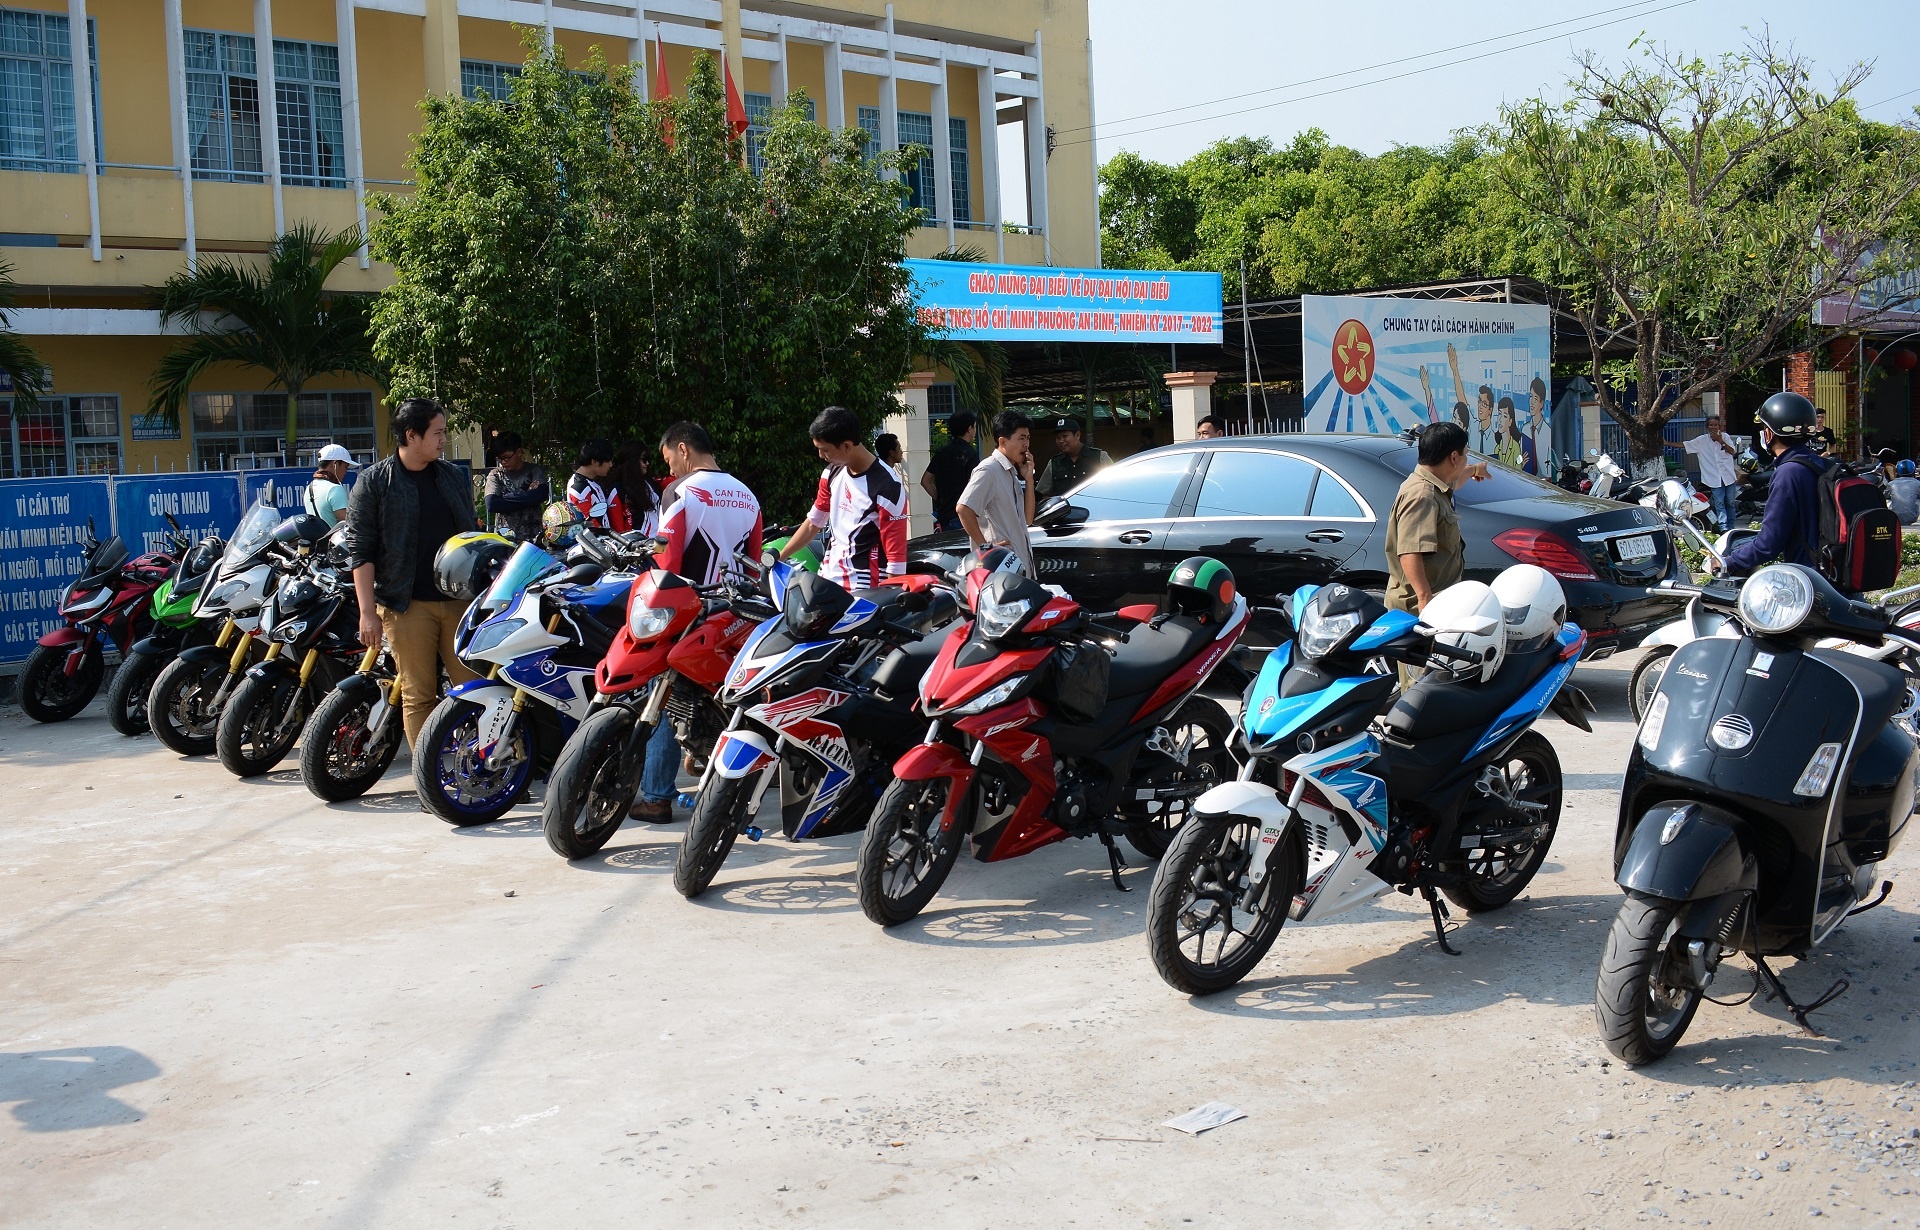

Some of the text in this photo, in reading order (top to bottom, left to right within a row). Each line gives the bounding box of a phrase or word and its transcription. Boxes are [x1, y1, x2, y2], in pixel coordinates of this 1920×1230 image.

[1029, 275, 1046, 300] ĐẠI
[1084, 278, 1097, 302] DỰ
[1098, 279, 1114, 303] ĐẠI
[1115, 276, 1132, 304] HỘI
[1133, 280, 1149, 304] ĐẠI
[948, 307, 973, 329] TNCS
[1009, 309, 1035, 330] MINH
[1078, 311, 1092, 330] AN
[1119, 309, 1147, 337] NHIỆM
[1162, 314, 1183, 333] 2017
[1191, 315, 1212, 333] 2022
[1383, 315, 1515, 334] CHUNG TAY CẢI CÁCH HÀNH CHÍNH
[16, 492, 70, 517] VÌ CẦN THƠ
[149, 489, 210, 517] CÙNG NHAU
[276, 486, 293, 508] CAO
[712, 499, 756, 513] MOTOBIKE
[714, 488, 752, 502] CAN THO
[21, 528, 47, 548] MINH
[49, 523, 73, 549] HIỆN
[8, 556, 43, 580] NGƯỜI,
[45, 551, 65, 577] MỖI
[67, 556, 83, 575] GIA
[12, 588, 37, 611] KIÊN
[4, 620, 25, 643] CÁC
[26, 618, 39, 644] TỆ
[1676, 662, 1709, 680] Vespa
